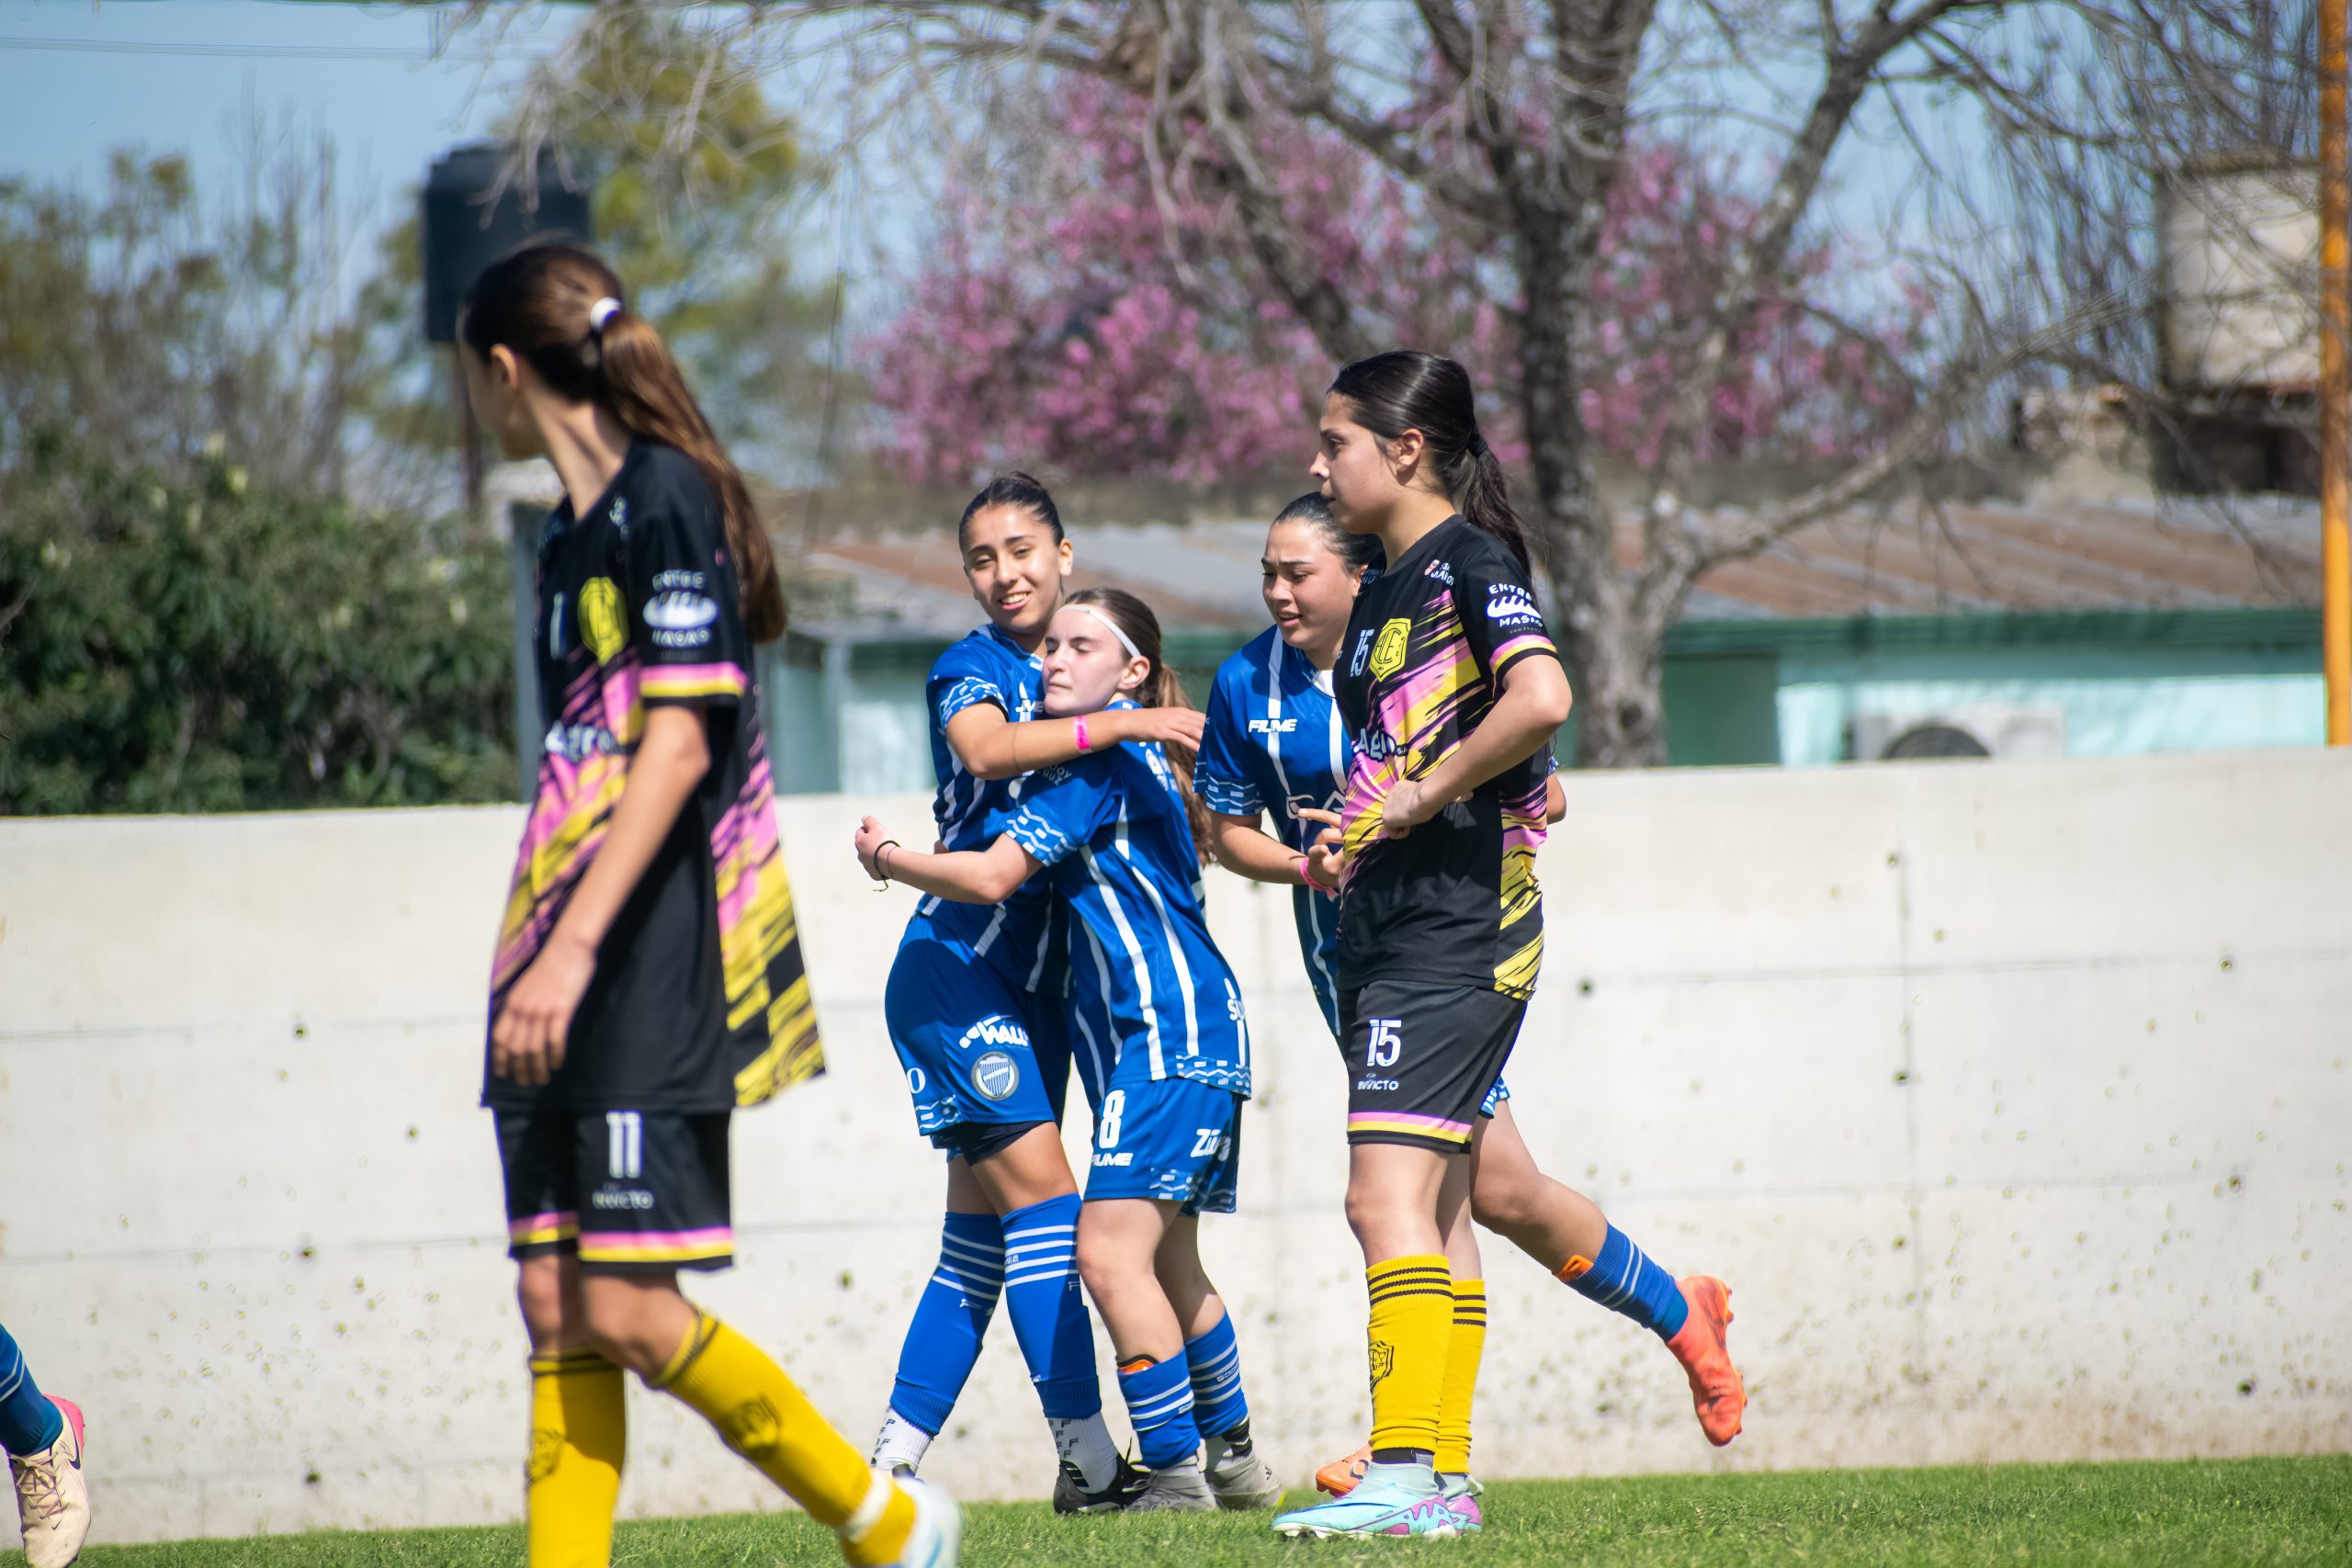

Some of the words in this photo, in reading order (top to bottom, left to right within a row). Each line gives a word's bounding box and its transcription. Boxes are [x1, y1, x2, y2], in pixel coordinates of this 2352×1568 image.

[1367, 1019, 1402, 1067] 15
[606, 1111, 641, 1179] 11
[1099, 1089, 1125, 1149] 8
